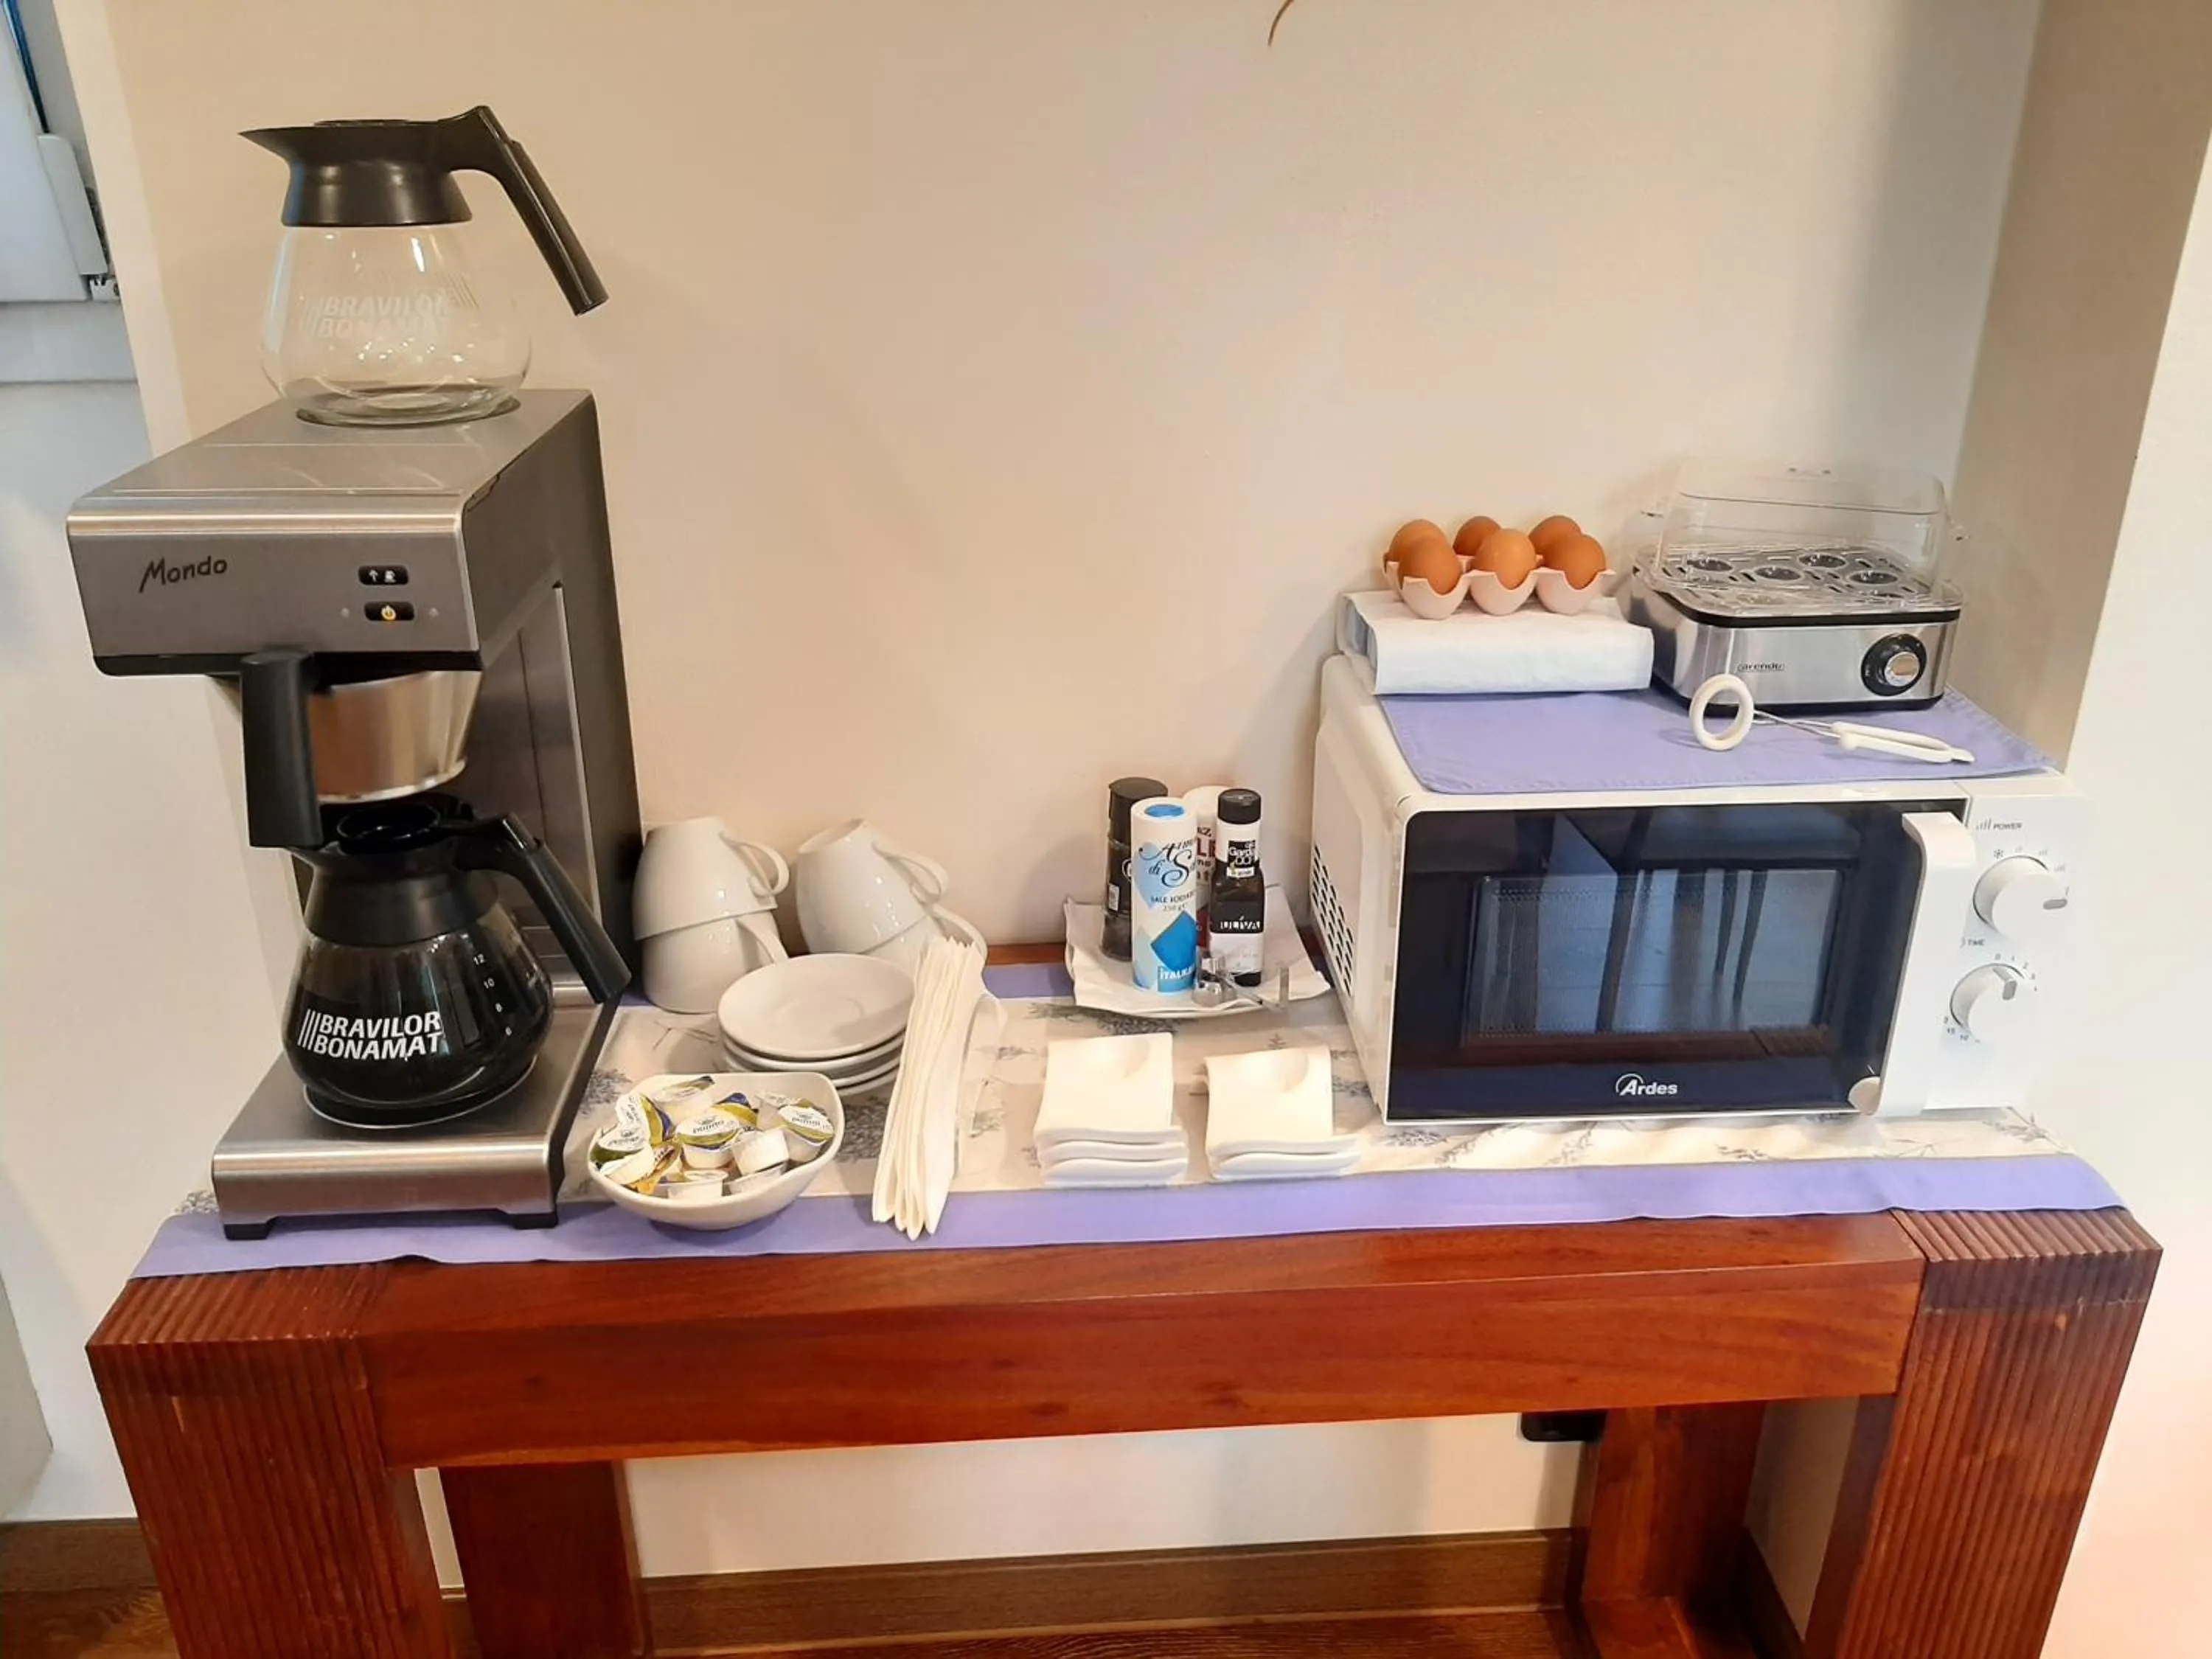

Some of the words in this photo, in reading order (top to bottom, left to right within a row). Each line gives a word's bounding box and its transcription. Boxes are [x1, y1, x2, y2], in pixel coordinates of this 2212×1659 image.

[139, 556, 228, 593] Mondo
[472, 953, 487, 966] 12
[483, 977, 495, 990] 10
[319, 1011, 441, 1038] BRAVILOR
[313, 1032, 443, 1060] BONAMAT
[1618, 1078, 1678, 1096] Ardes
